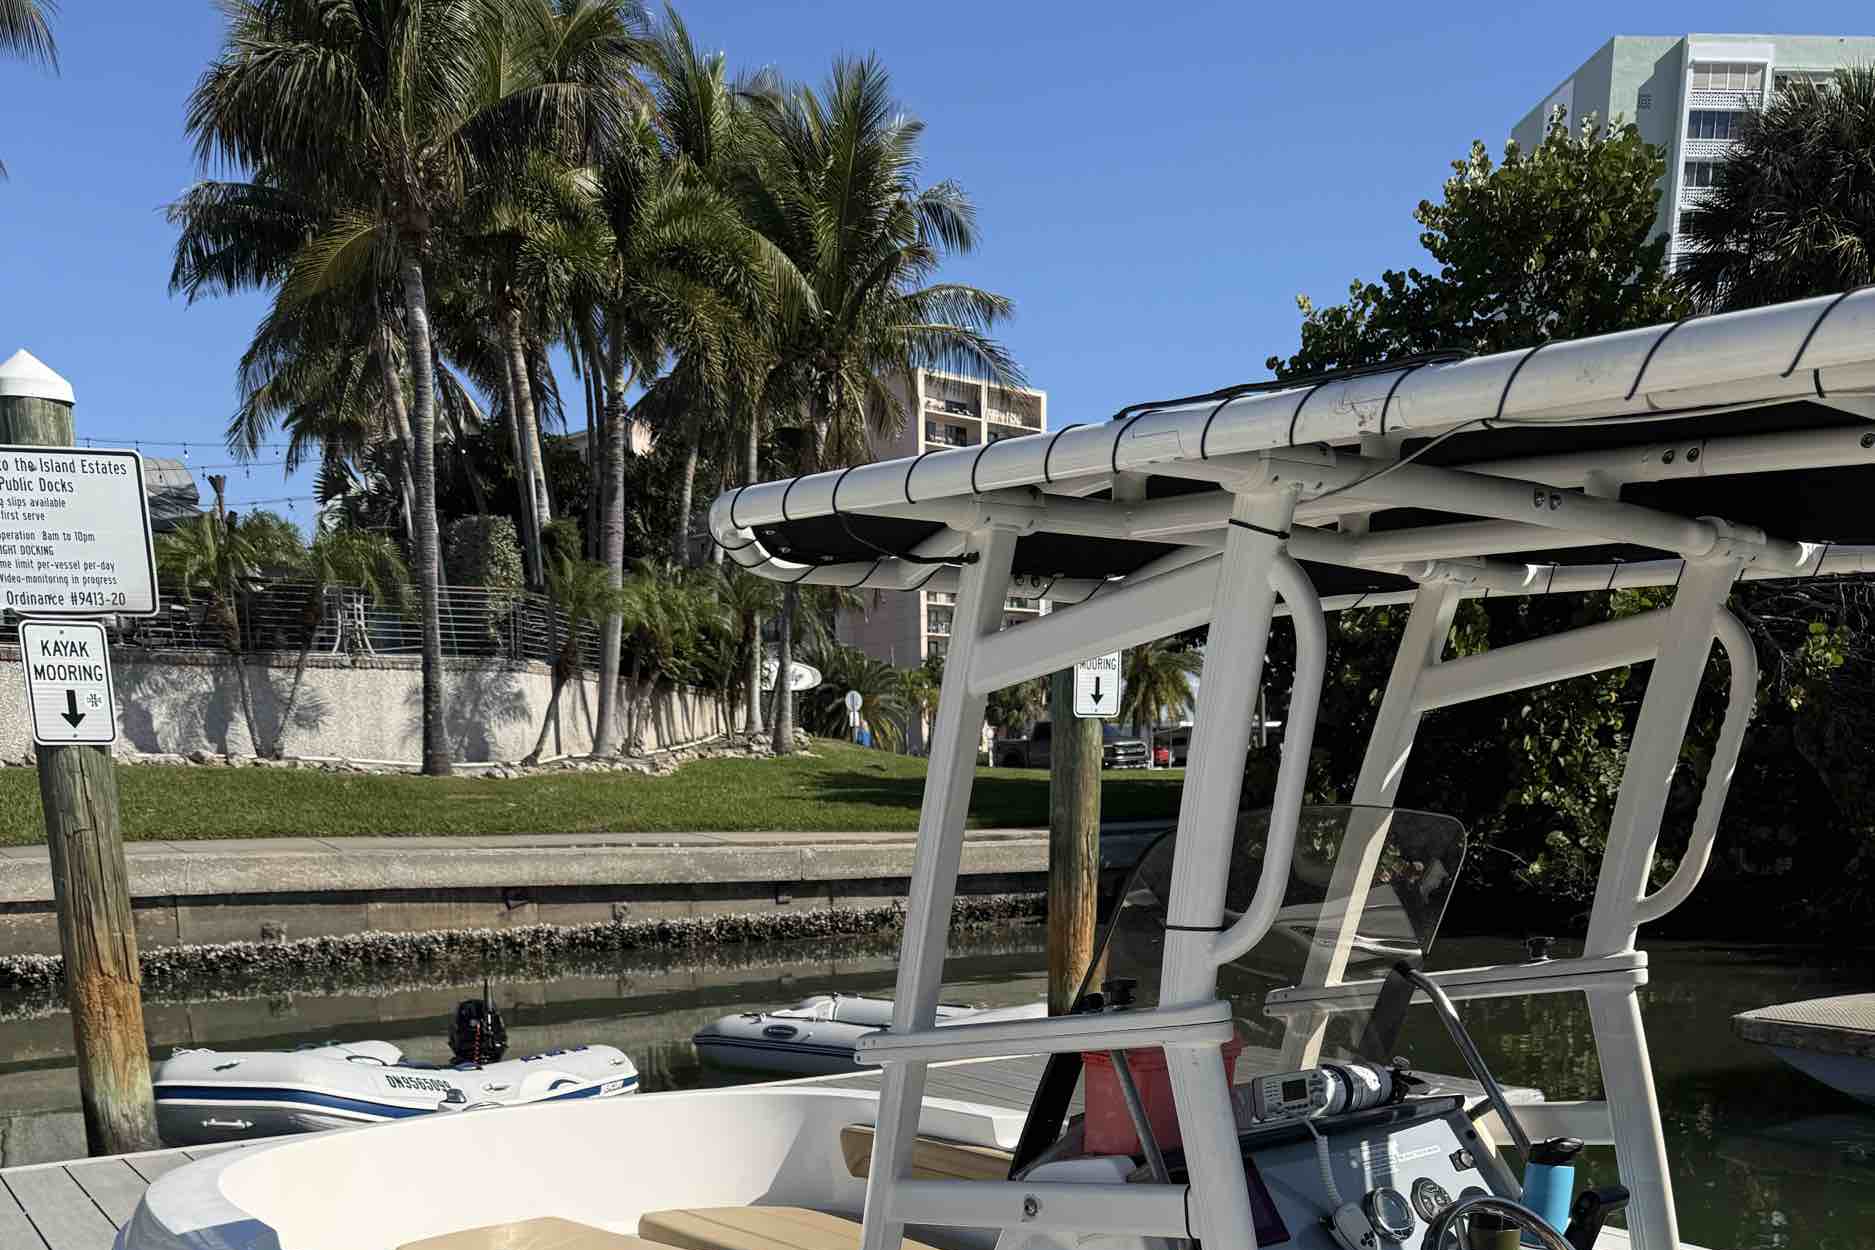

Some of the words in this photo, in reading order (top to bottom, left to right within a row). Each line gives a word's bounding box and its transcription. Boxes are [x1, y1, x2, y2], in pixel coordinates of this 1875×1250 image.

[15, 459, 36, 472] the
[40, 458, 76, 473] Island
[81, 460, 127, 475] Estates
[0, 477, 34, 492] Public
[39, 478, 74, 493] Docks
[7, 497, 26, 509] slips
[30, 499, 66, 508] available
[1, 510, 19, 521] first
[22, 513, 45, 521] serve
[0, 531, 35, 541] peration
[42, 531, 59, 541] 8am
[62, 532, 72, 541] to
[74, 531, 95, 543] 10pm
[20, 545, 54, 556] DOCKING
[15, 559, 34, 569] limit
[37, 560, 80, 571] per-vessel
[83, 561, 115, 573] per-day
[0, 573, 69, 586] Video-monitoring
[71, 574, 80, 584] in
[82, 575, 117, 586] progress
[6, 591, 65, 606] Ordinance
[70, 592, 126, 607] #9413-20
[40, 640, 90, 657] KAYAK
[33, 664, 103, 682] MOORING
